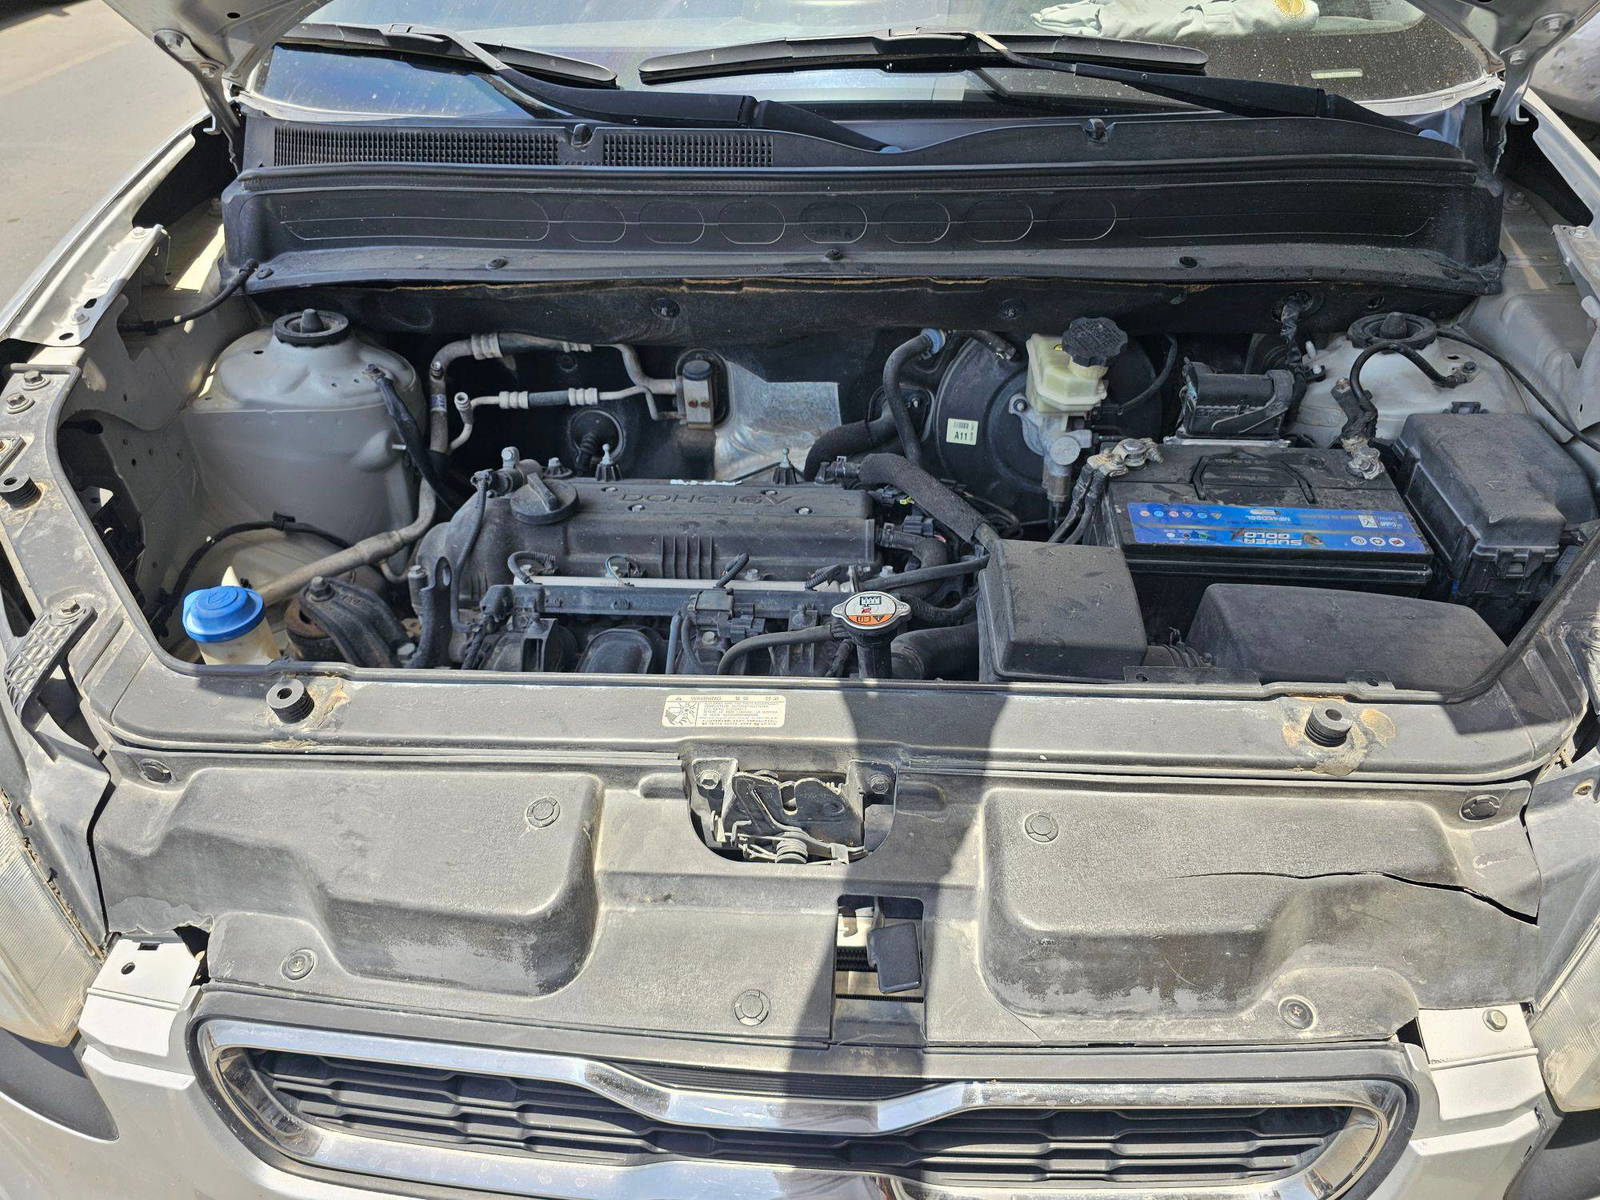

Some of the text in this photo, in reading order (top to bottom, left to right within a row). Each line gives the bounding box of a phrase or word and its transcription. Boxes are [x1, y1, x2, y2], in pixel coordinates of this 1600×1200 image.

[954, 431, 968, 441] A11
[621, 493, 793, 507] DOHC 16V
[1244, 532, 1291, 540] GOLD
[1243, 538, 1303, 546] SUPER
